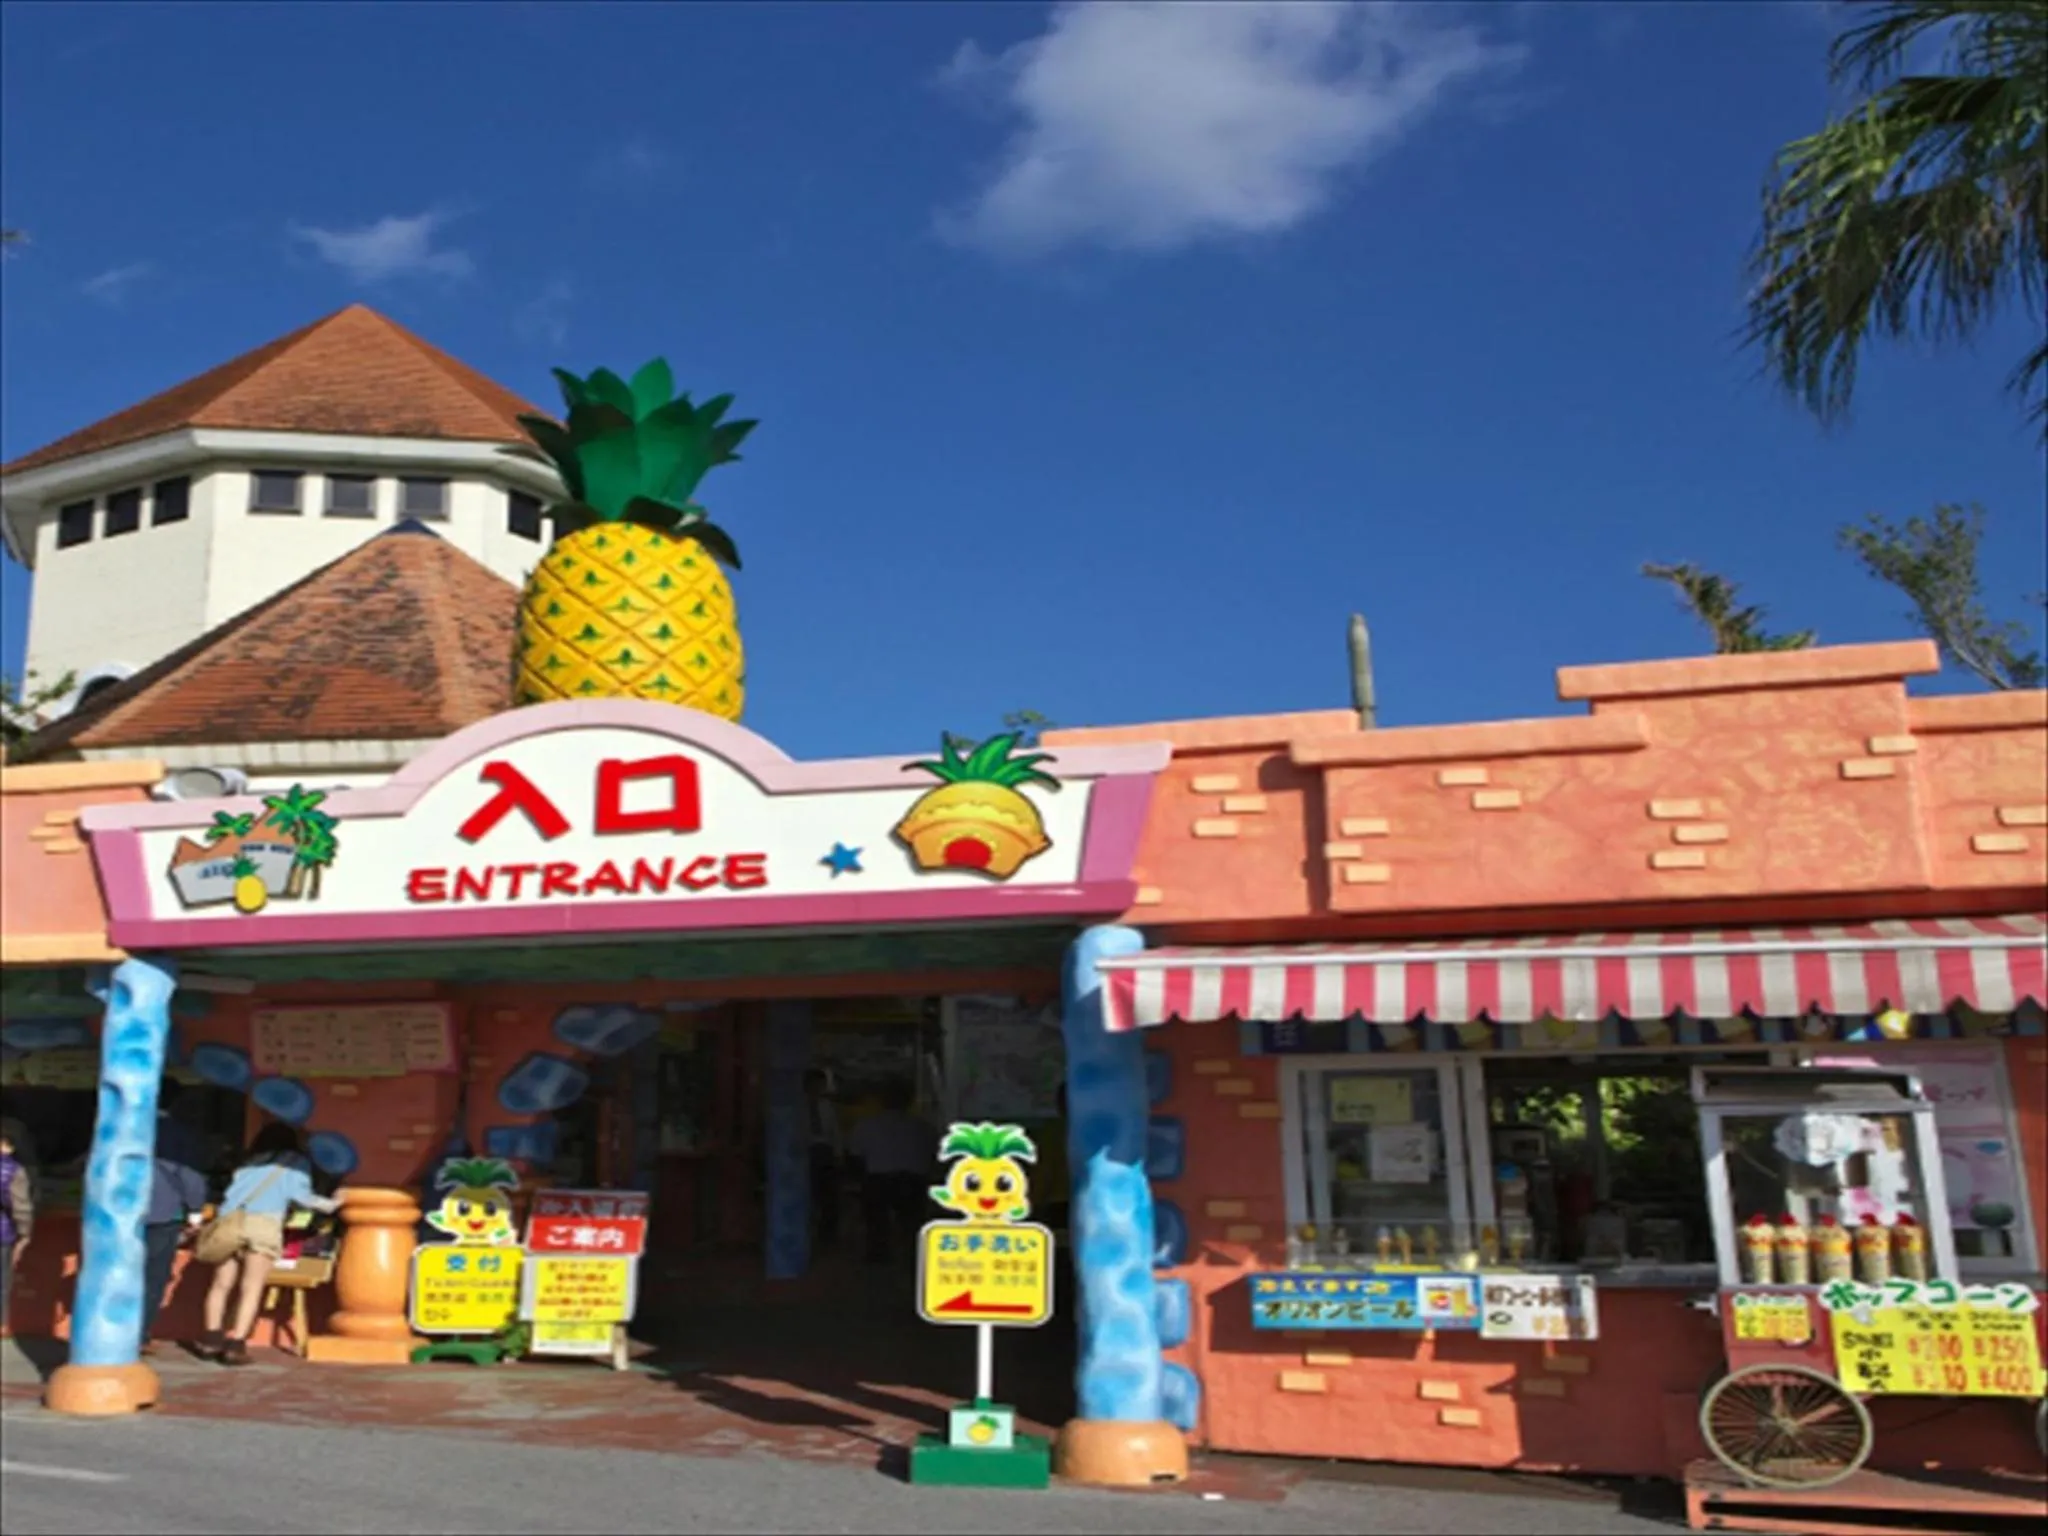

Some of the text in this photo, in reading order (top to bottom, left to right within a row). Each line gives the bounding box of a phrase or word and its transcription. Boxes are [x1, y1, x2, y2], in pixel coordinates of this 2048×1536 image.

[456, 754, 702, 845] 入口
[407, 853, 768, 902] ENTRANCE
[546, 1226, 625, 1249] ご案内
[938, 1234, 1038, 1253] お手洗い
[446, 1253, 501, 1273] 受付
[1264, 1299, 1414, 1320] オリオンビール
